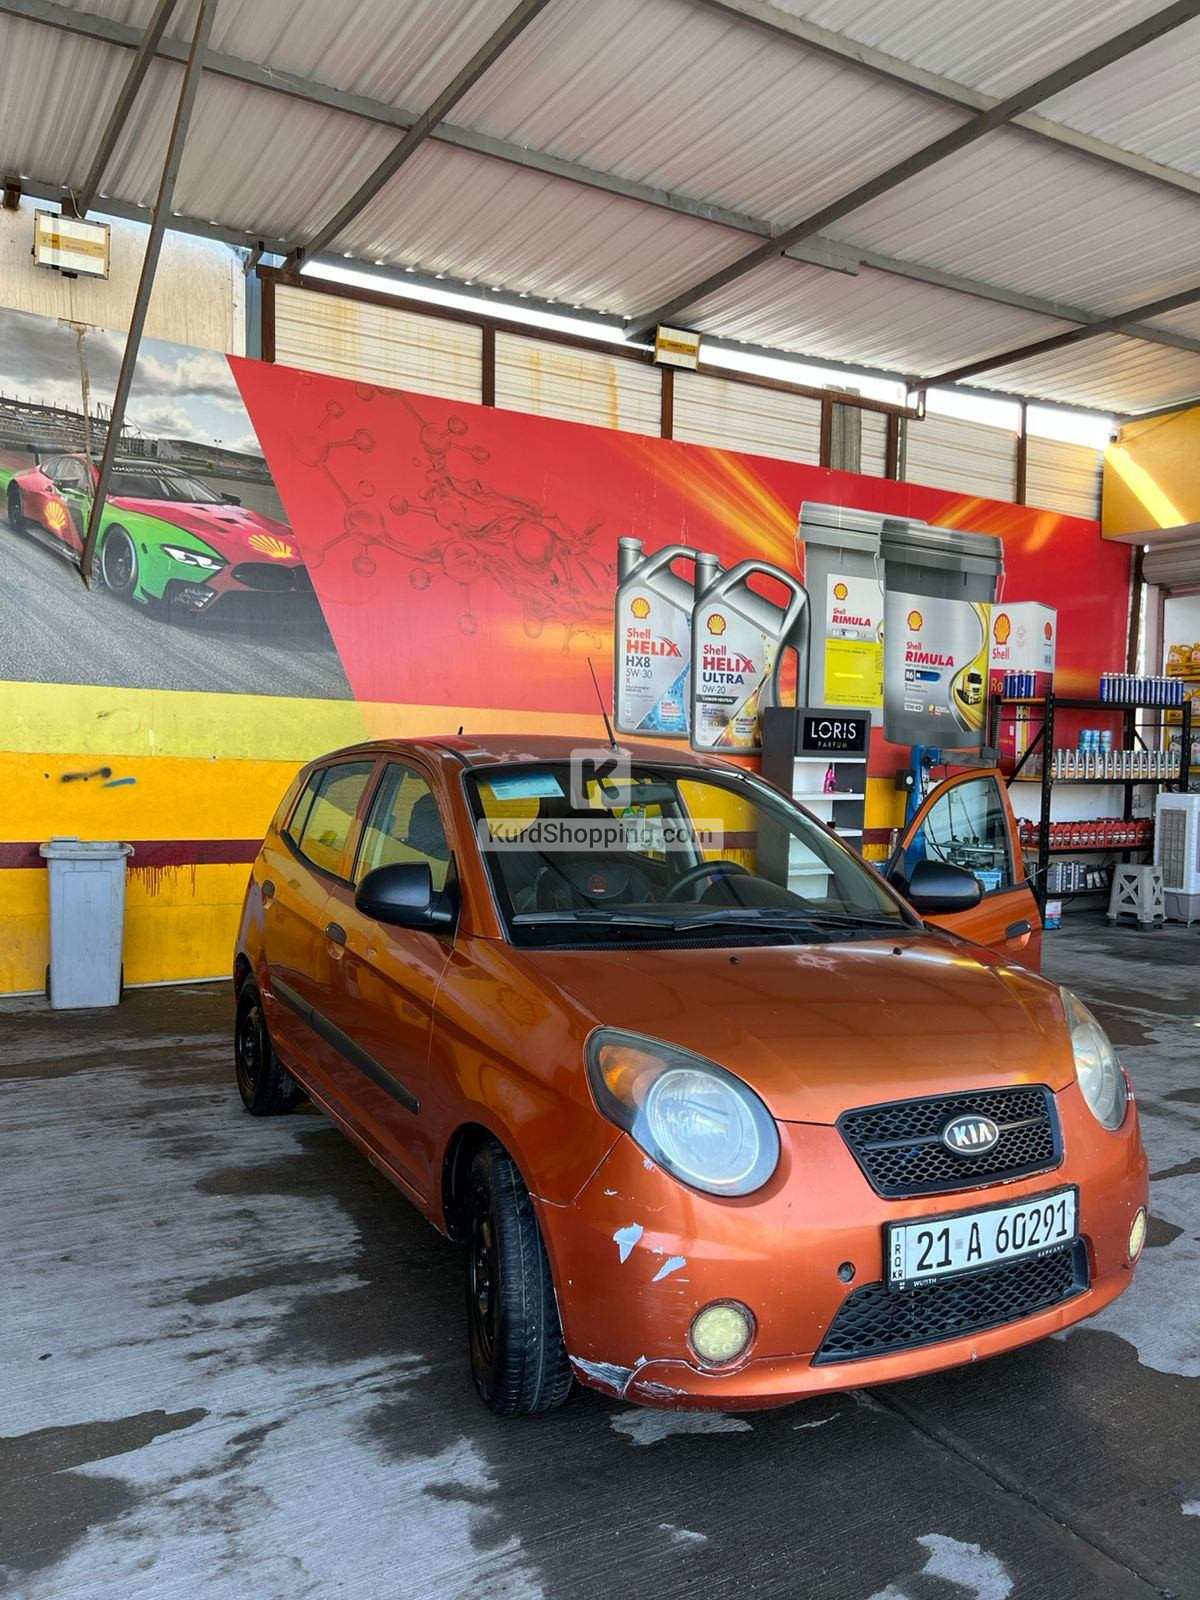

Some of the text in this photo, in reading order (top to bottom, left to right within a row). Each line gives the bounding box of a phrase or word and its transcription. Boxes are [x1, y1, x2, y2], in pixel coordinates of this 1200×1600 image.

[832, 615, 871, 627] RIMULA
[627, 627, 651, 639] Shell
[626, 636, 682, 657] HELIX
[703, 644, 727, 656] Shell
[906, 641, 922, 650] Shell
[905, 650, 954, 667] RIMULA
[992, 648, 1010, 660] Shell
[626, 656, 651, 668] HX8
[703, 653, 756, 674] HELIX
[625, 669, 653, 679] 5W-30
[702, 672, 744, 684] ULTRA
[702, 685, 726, 694] 0W-20
[811, 721, 857, 739] LORIS
[818, 741, 848, 749] PARFUM
[952, 1123, 993, 1147] KIA
[916, 1199, 1067, 1271] 21 A 60291
[892, 1269, 903, 1280] KR
